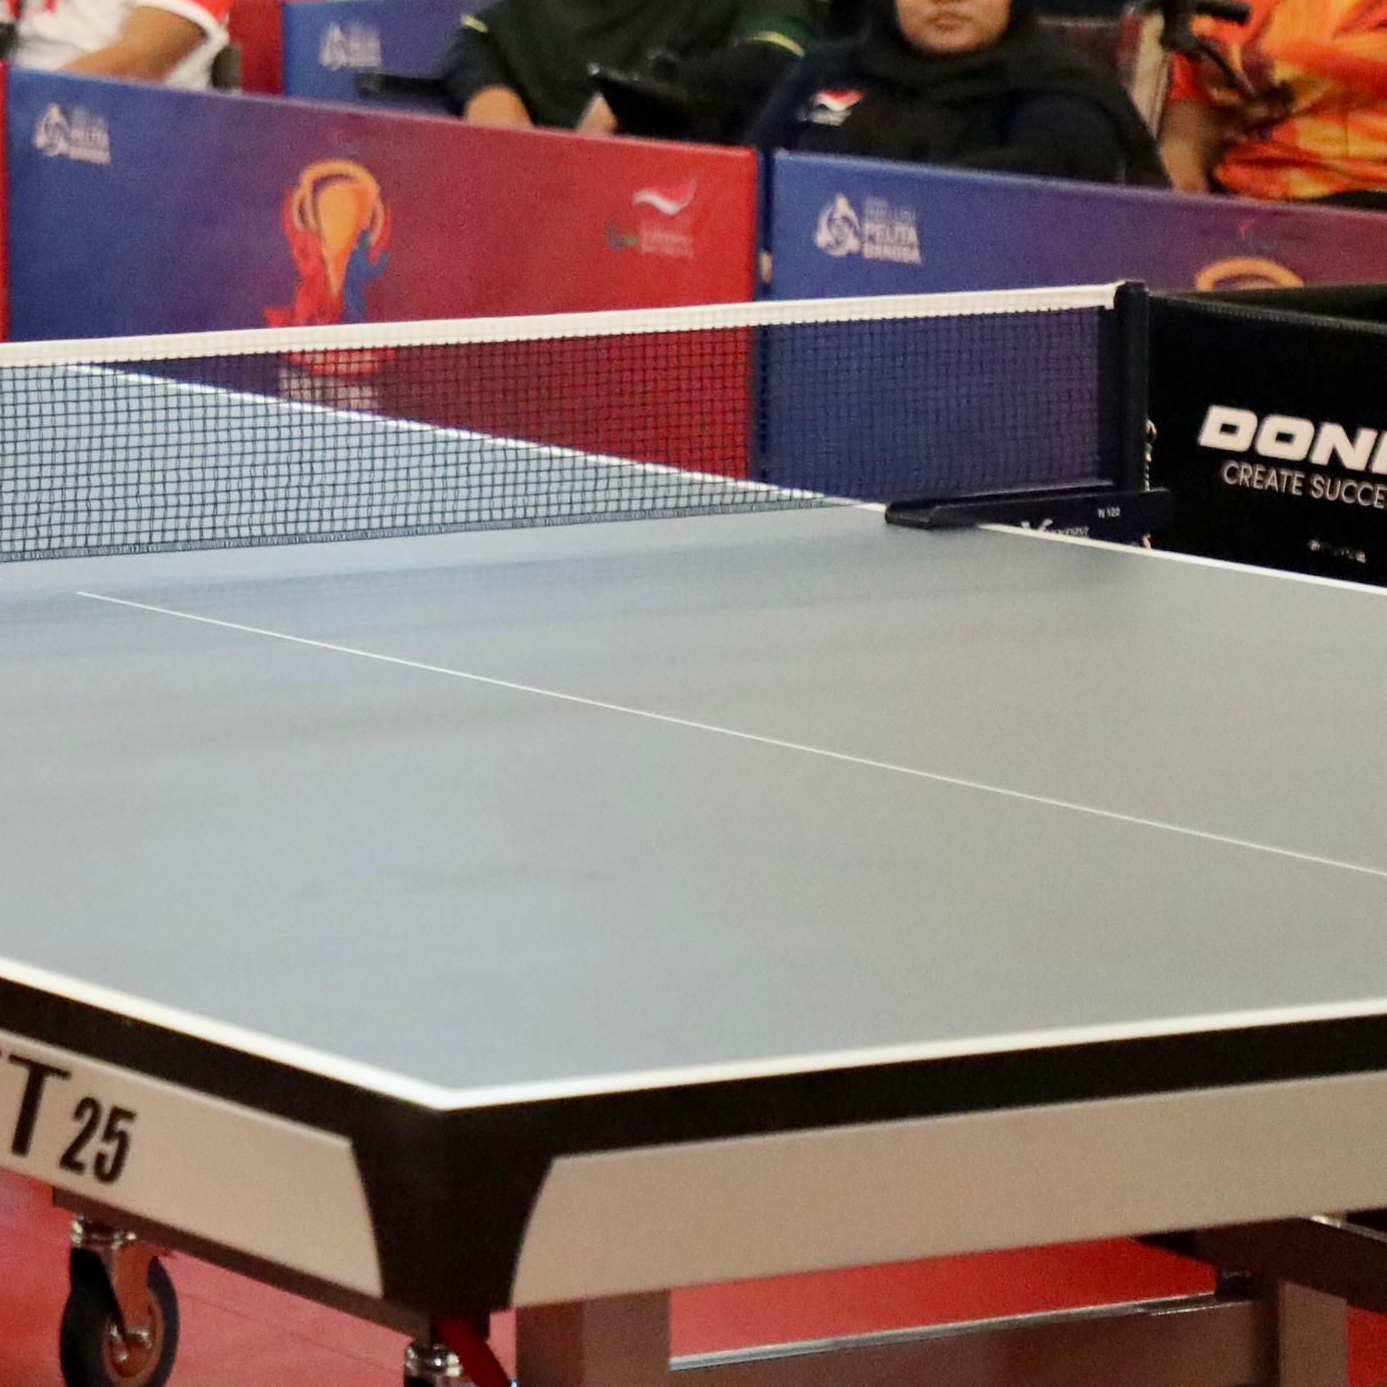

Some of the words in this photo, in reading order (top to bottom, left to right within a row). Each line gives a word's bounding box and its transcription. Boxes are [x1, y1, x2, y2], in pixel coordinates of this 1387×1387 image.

[1223, 461, 1305, 497] CREATE
[1310, 474, 1387, 510] SUCCE
[59, 1096, 138, 1185] 25
